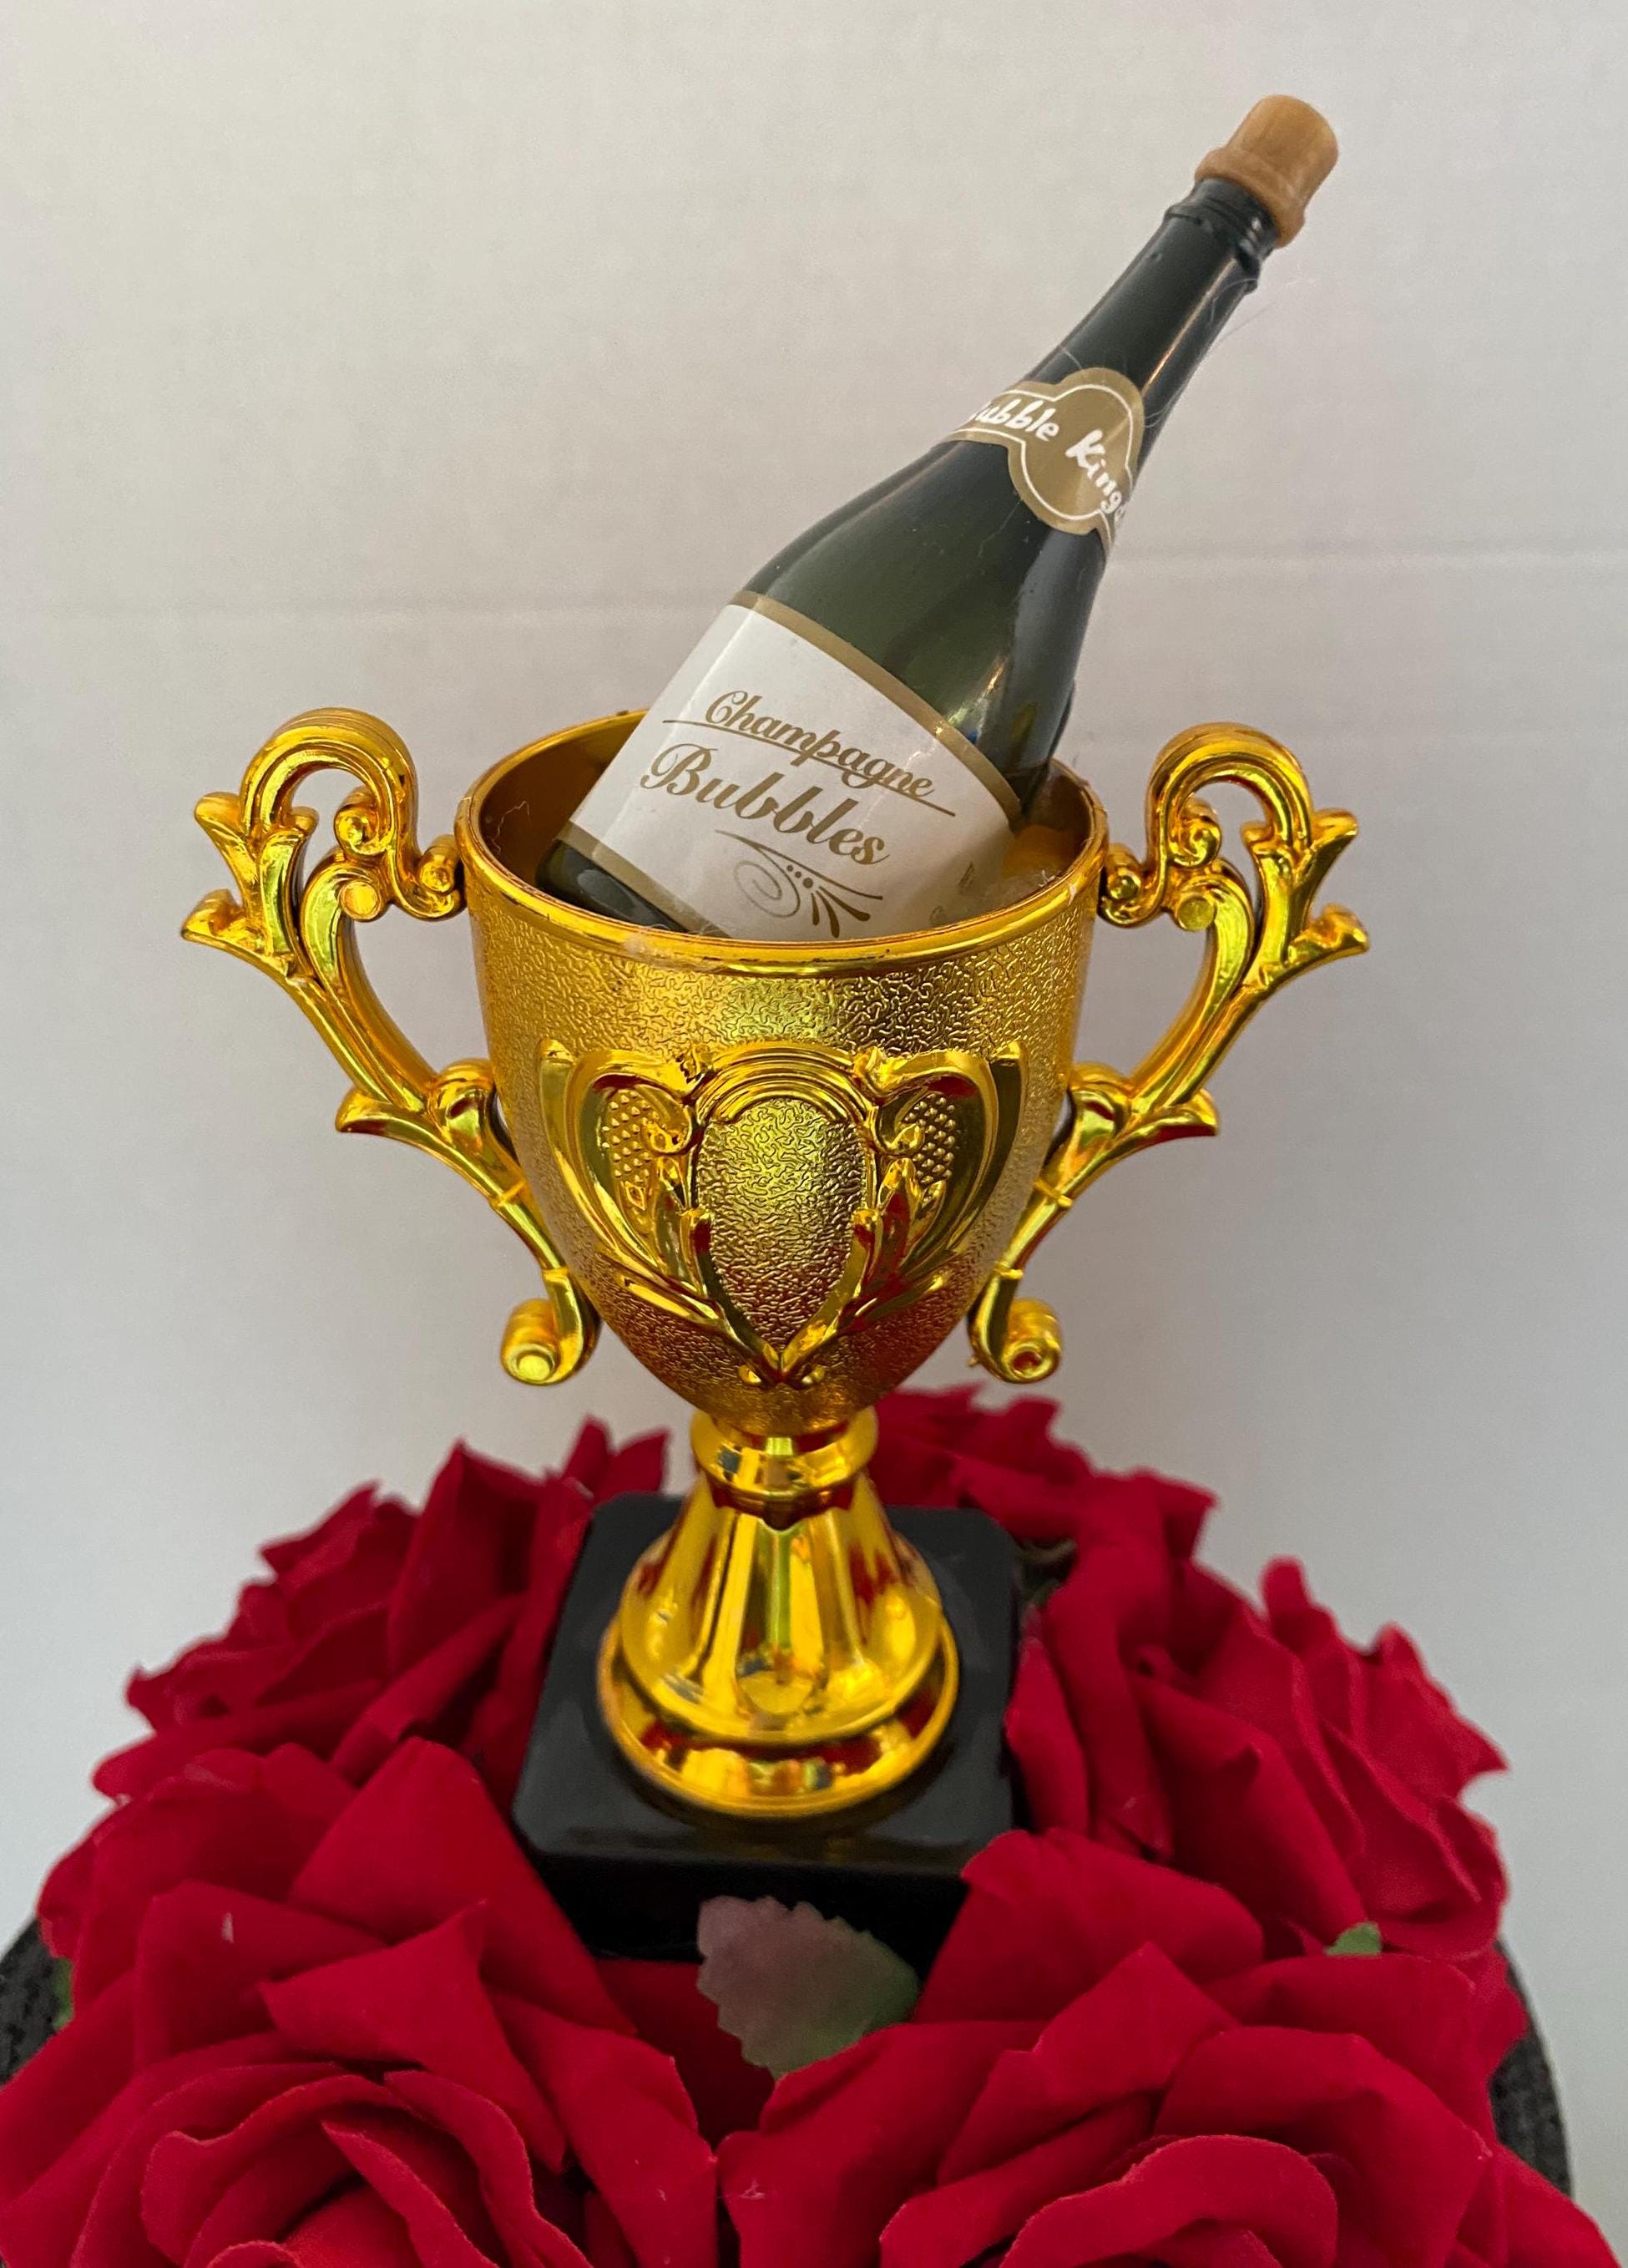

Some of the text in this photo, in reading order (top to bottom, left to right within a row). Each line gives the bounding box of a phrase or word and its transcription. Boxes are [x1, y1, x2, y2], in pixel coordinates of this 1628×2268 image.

[971, 398, 1059, 441] ubble
[705, 691, 935, 797] Champagne
[640, 742, 890, 865] Bubbles
